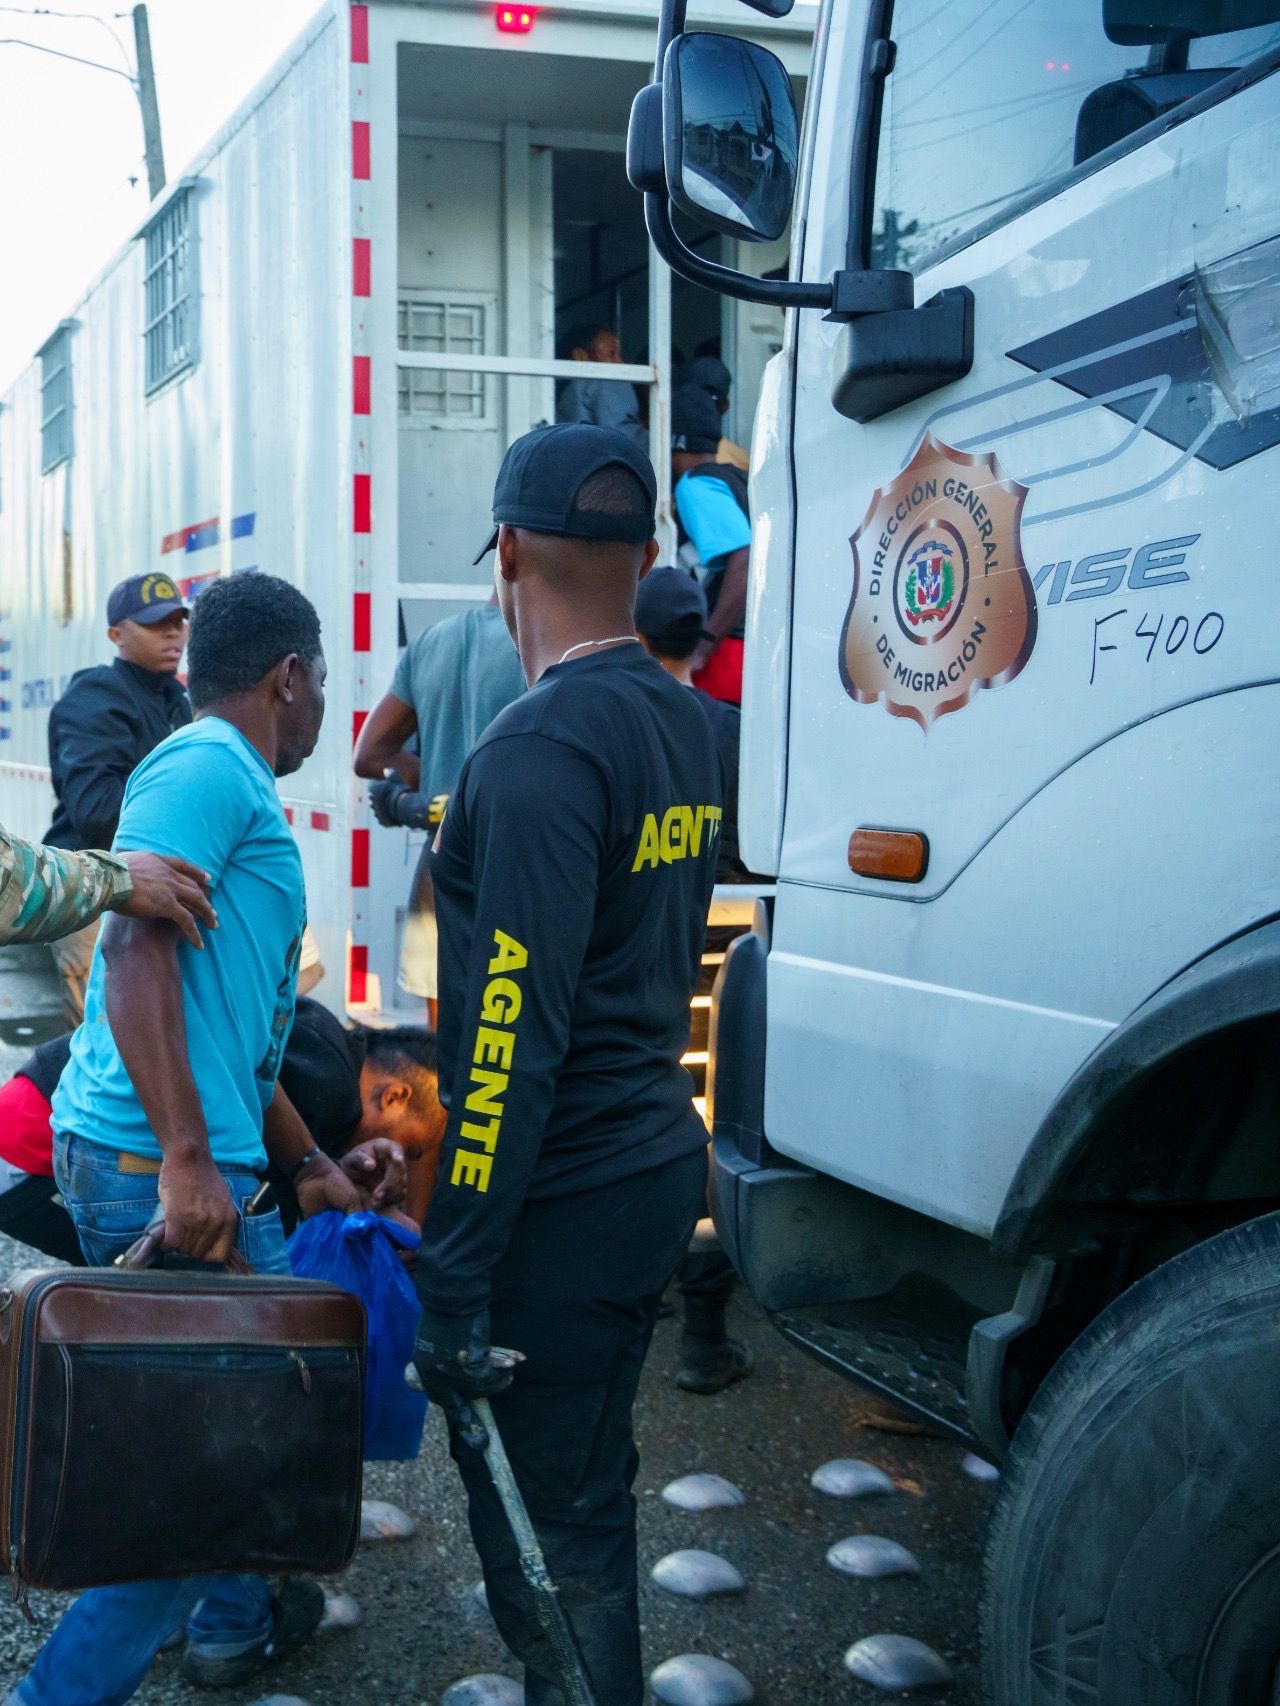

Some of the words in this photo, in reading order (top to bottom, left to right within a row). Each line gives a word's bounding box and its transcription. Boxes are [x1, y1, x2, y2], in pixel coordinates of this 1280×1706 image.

[869, 478, 937, 596] DIRECCIÓN
[942, 478, 999, 578] GENERAL
[876, 633, 896, 669] DE
[893, 621, 987, 692] MIGRACIÓN
[451, 928, 528, 1193] AGENTE
